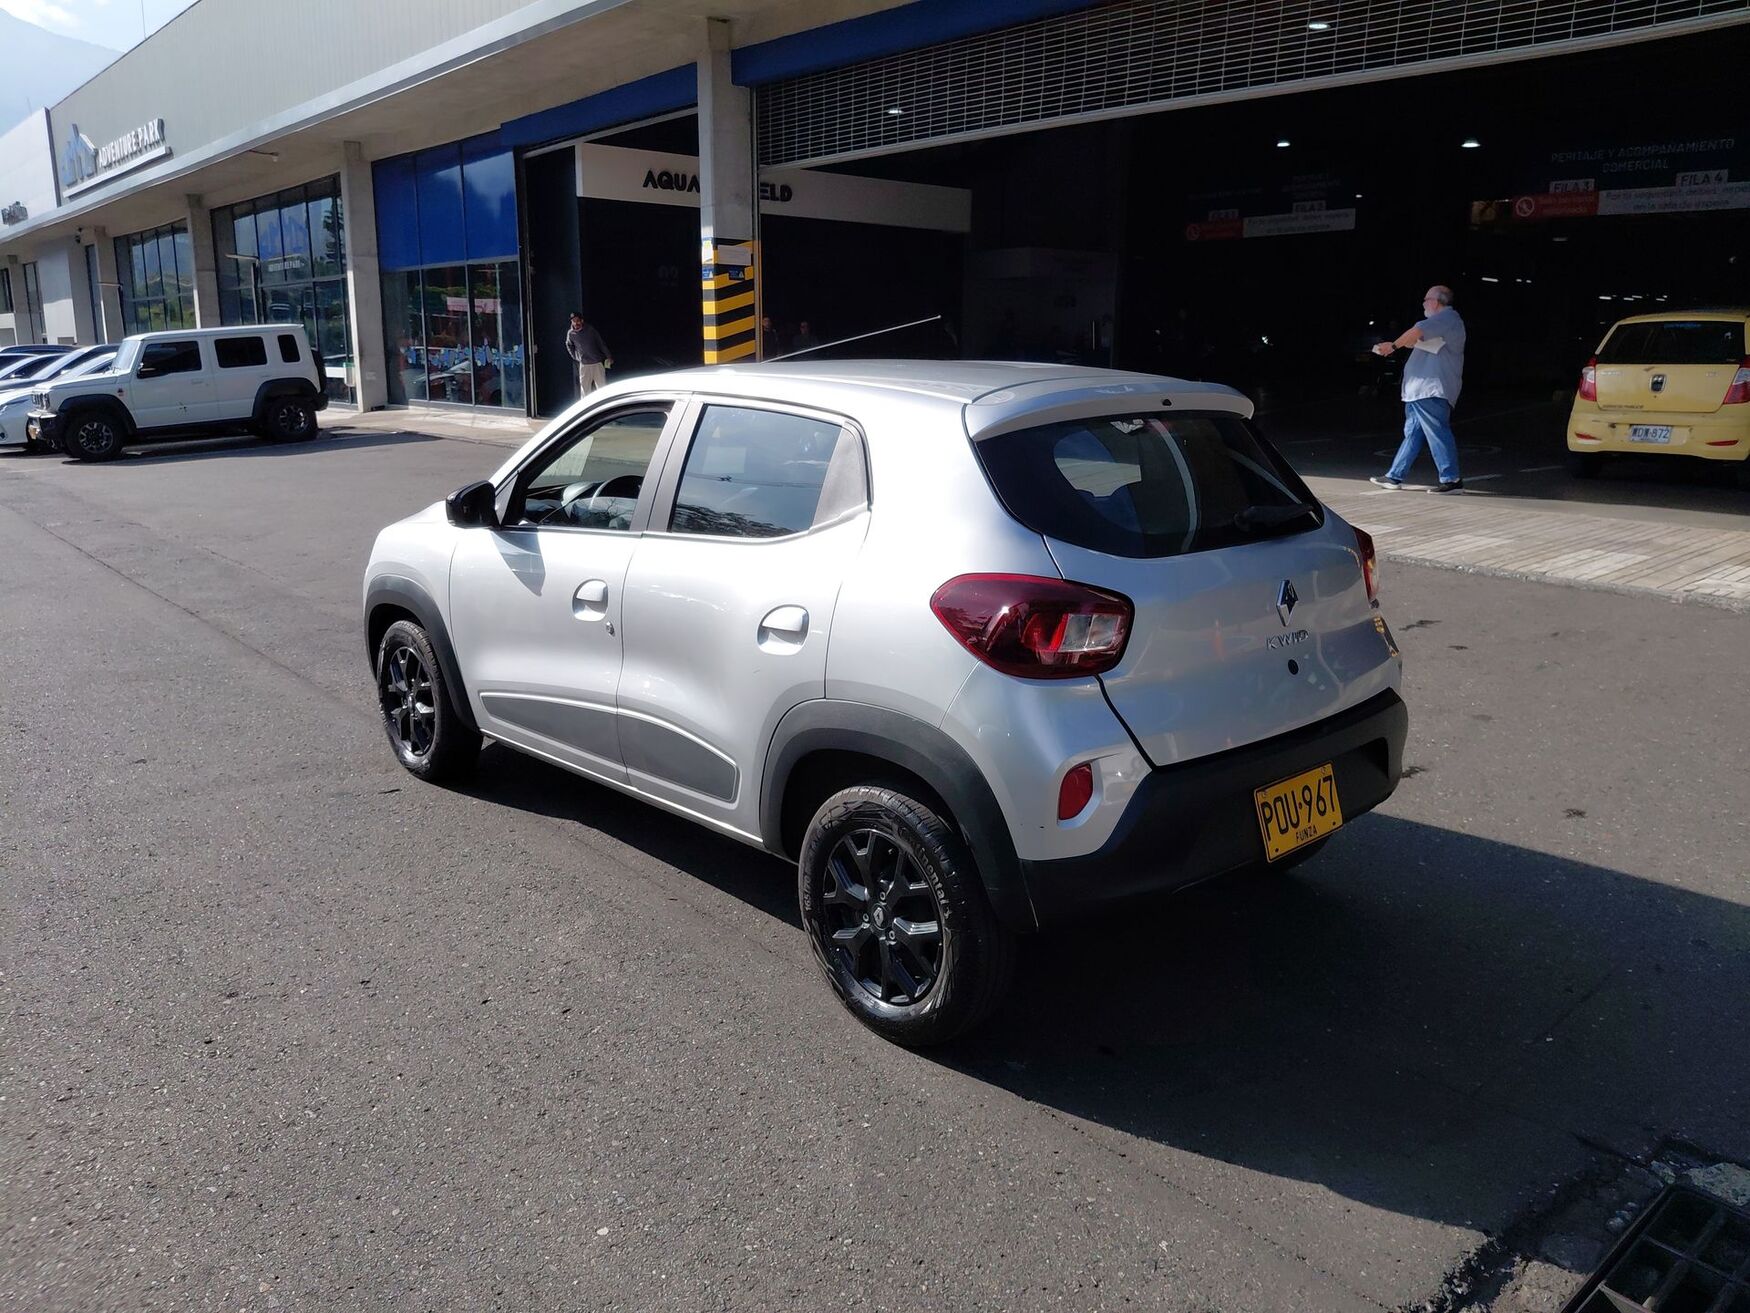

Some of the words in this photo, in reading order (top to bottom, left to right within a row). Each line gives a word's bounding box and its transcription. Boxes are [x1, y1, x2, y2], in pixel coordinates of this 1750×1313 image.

[98, 130, 138, 168] ADVENTURE
[138, 118, 164, 148] PARK
[1551, 149, 1603, 163] PERITAJE
[1608, 148, 1615, 158] Y
[1602, 159, 1670, 174] COMERCIAL
[1680, 174, 1710, 186] FILA
[1714, 171, 1723, 182] 4
[1553, 181, 1580, 194] FILA
[1265, 629, 1309, 651] KWID
[1295, 825, 1318, 844] FUNZA
